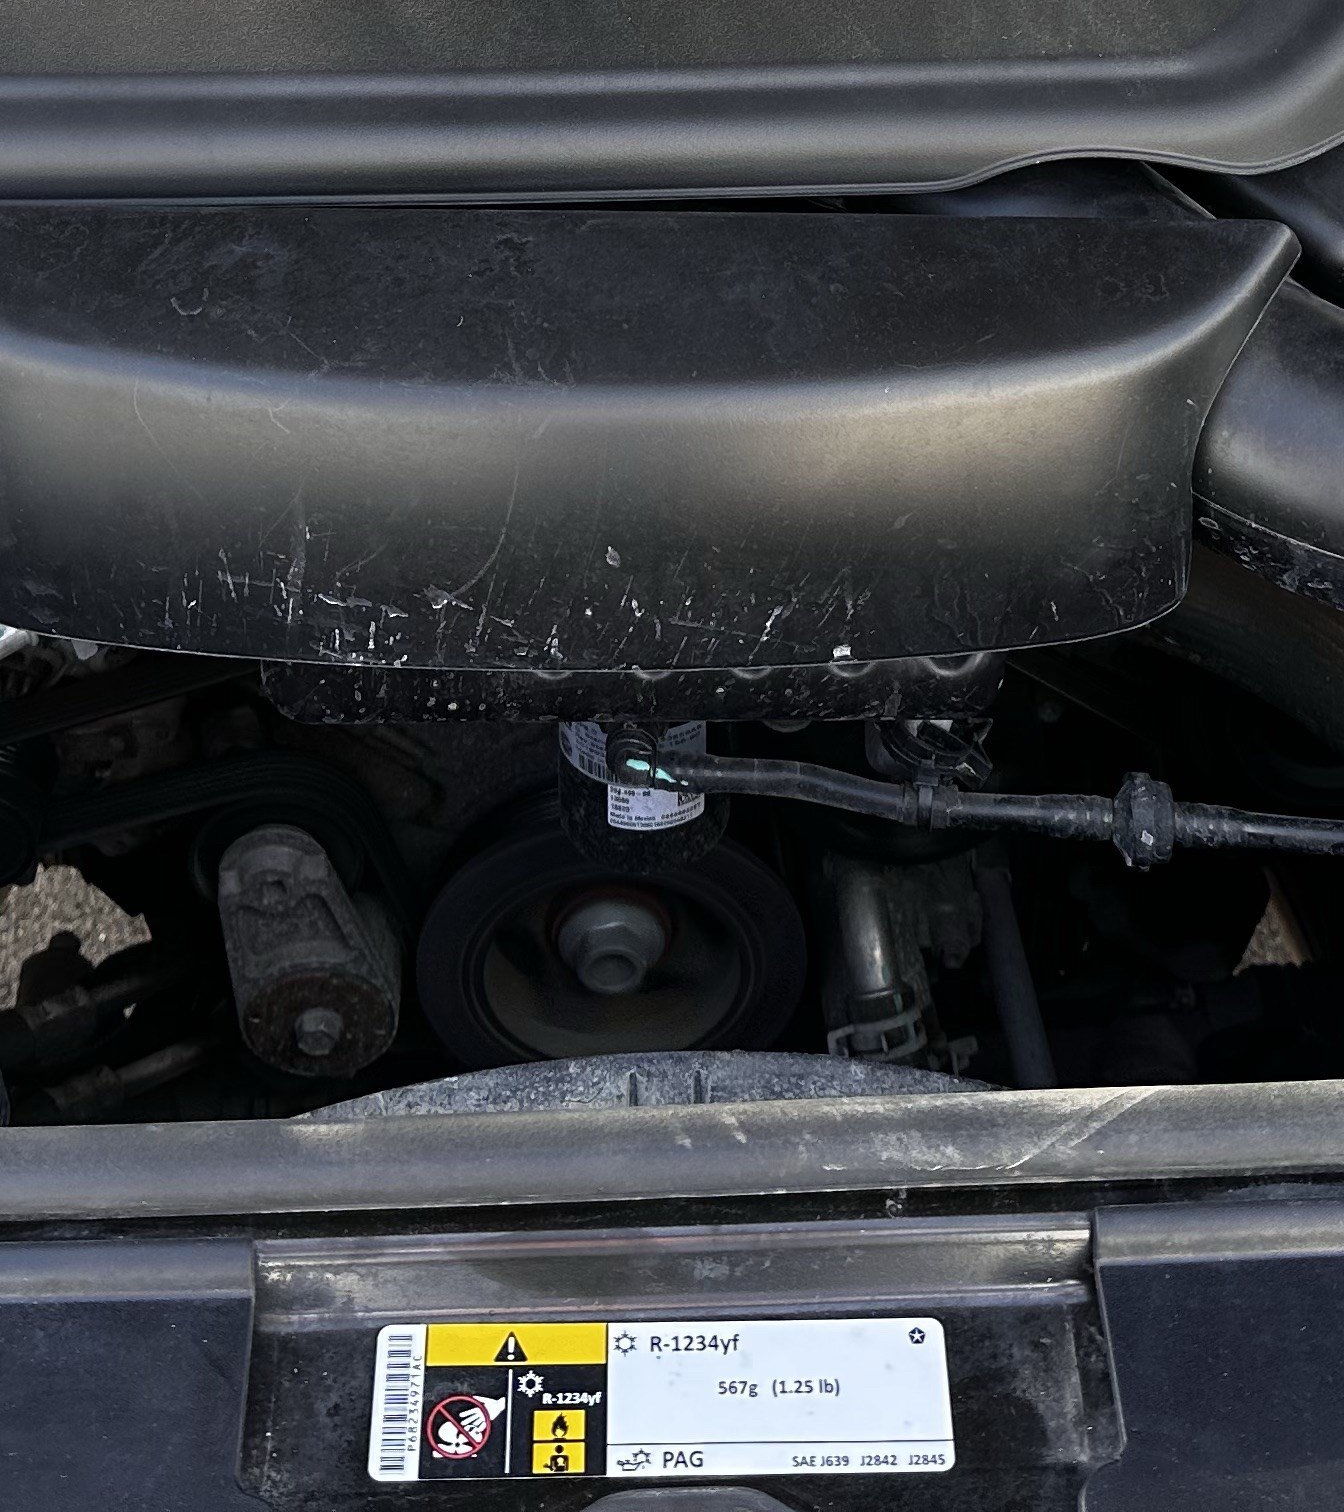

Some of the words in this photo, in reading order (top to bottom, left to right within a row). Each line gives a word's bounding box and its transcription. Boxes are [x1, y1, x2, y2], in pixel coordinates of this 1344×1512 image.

[650, 1334, 740, 1355] R-1234yf
[718, 1381, 758, 1397] 567g
[772, 1380, 813, 1397] (1.25
[818, 1378, 841, 1396] lb)
[407, 1355, 423, 1452] P68234971AC
[541, 1392, 602, 1406] R-1234yf
[662, 1451, 704, 1469] PAG
[792, 1455, 817, 1467] SAE
[820, 1455, 850, 1467] J639
[860, 1454, 898, 1467] J2842
[908, 1453, 946, 1466] J2845
